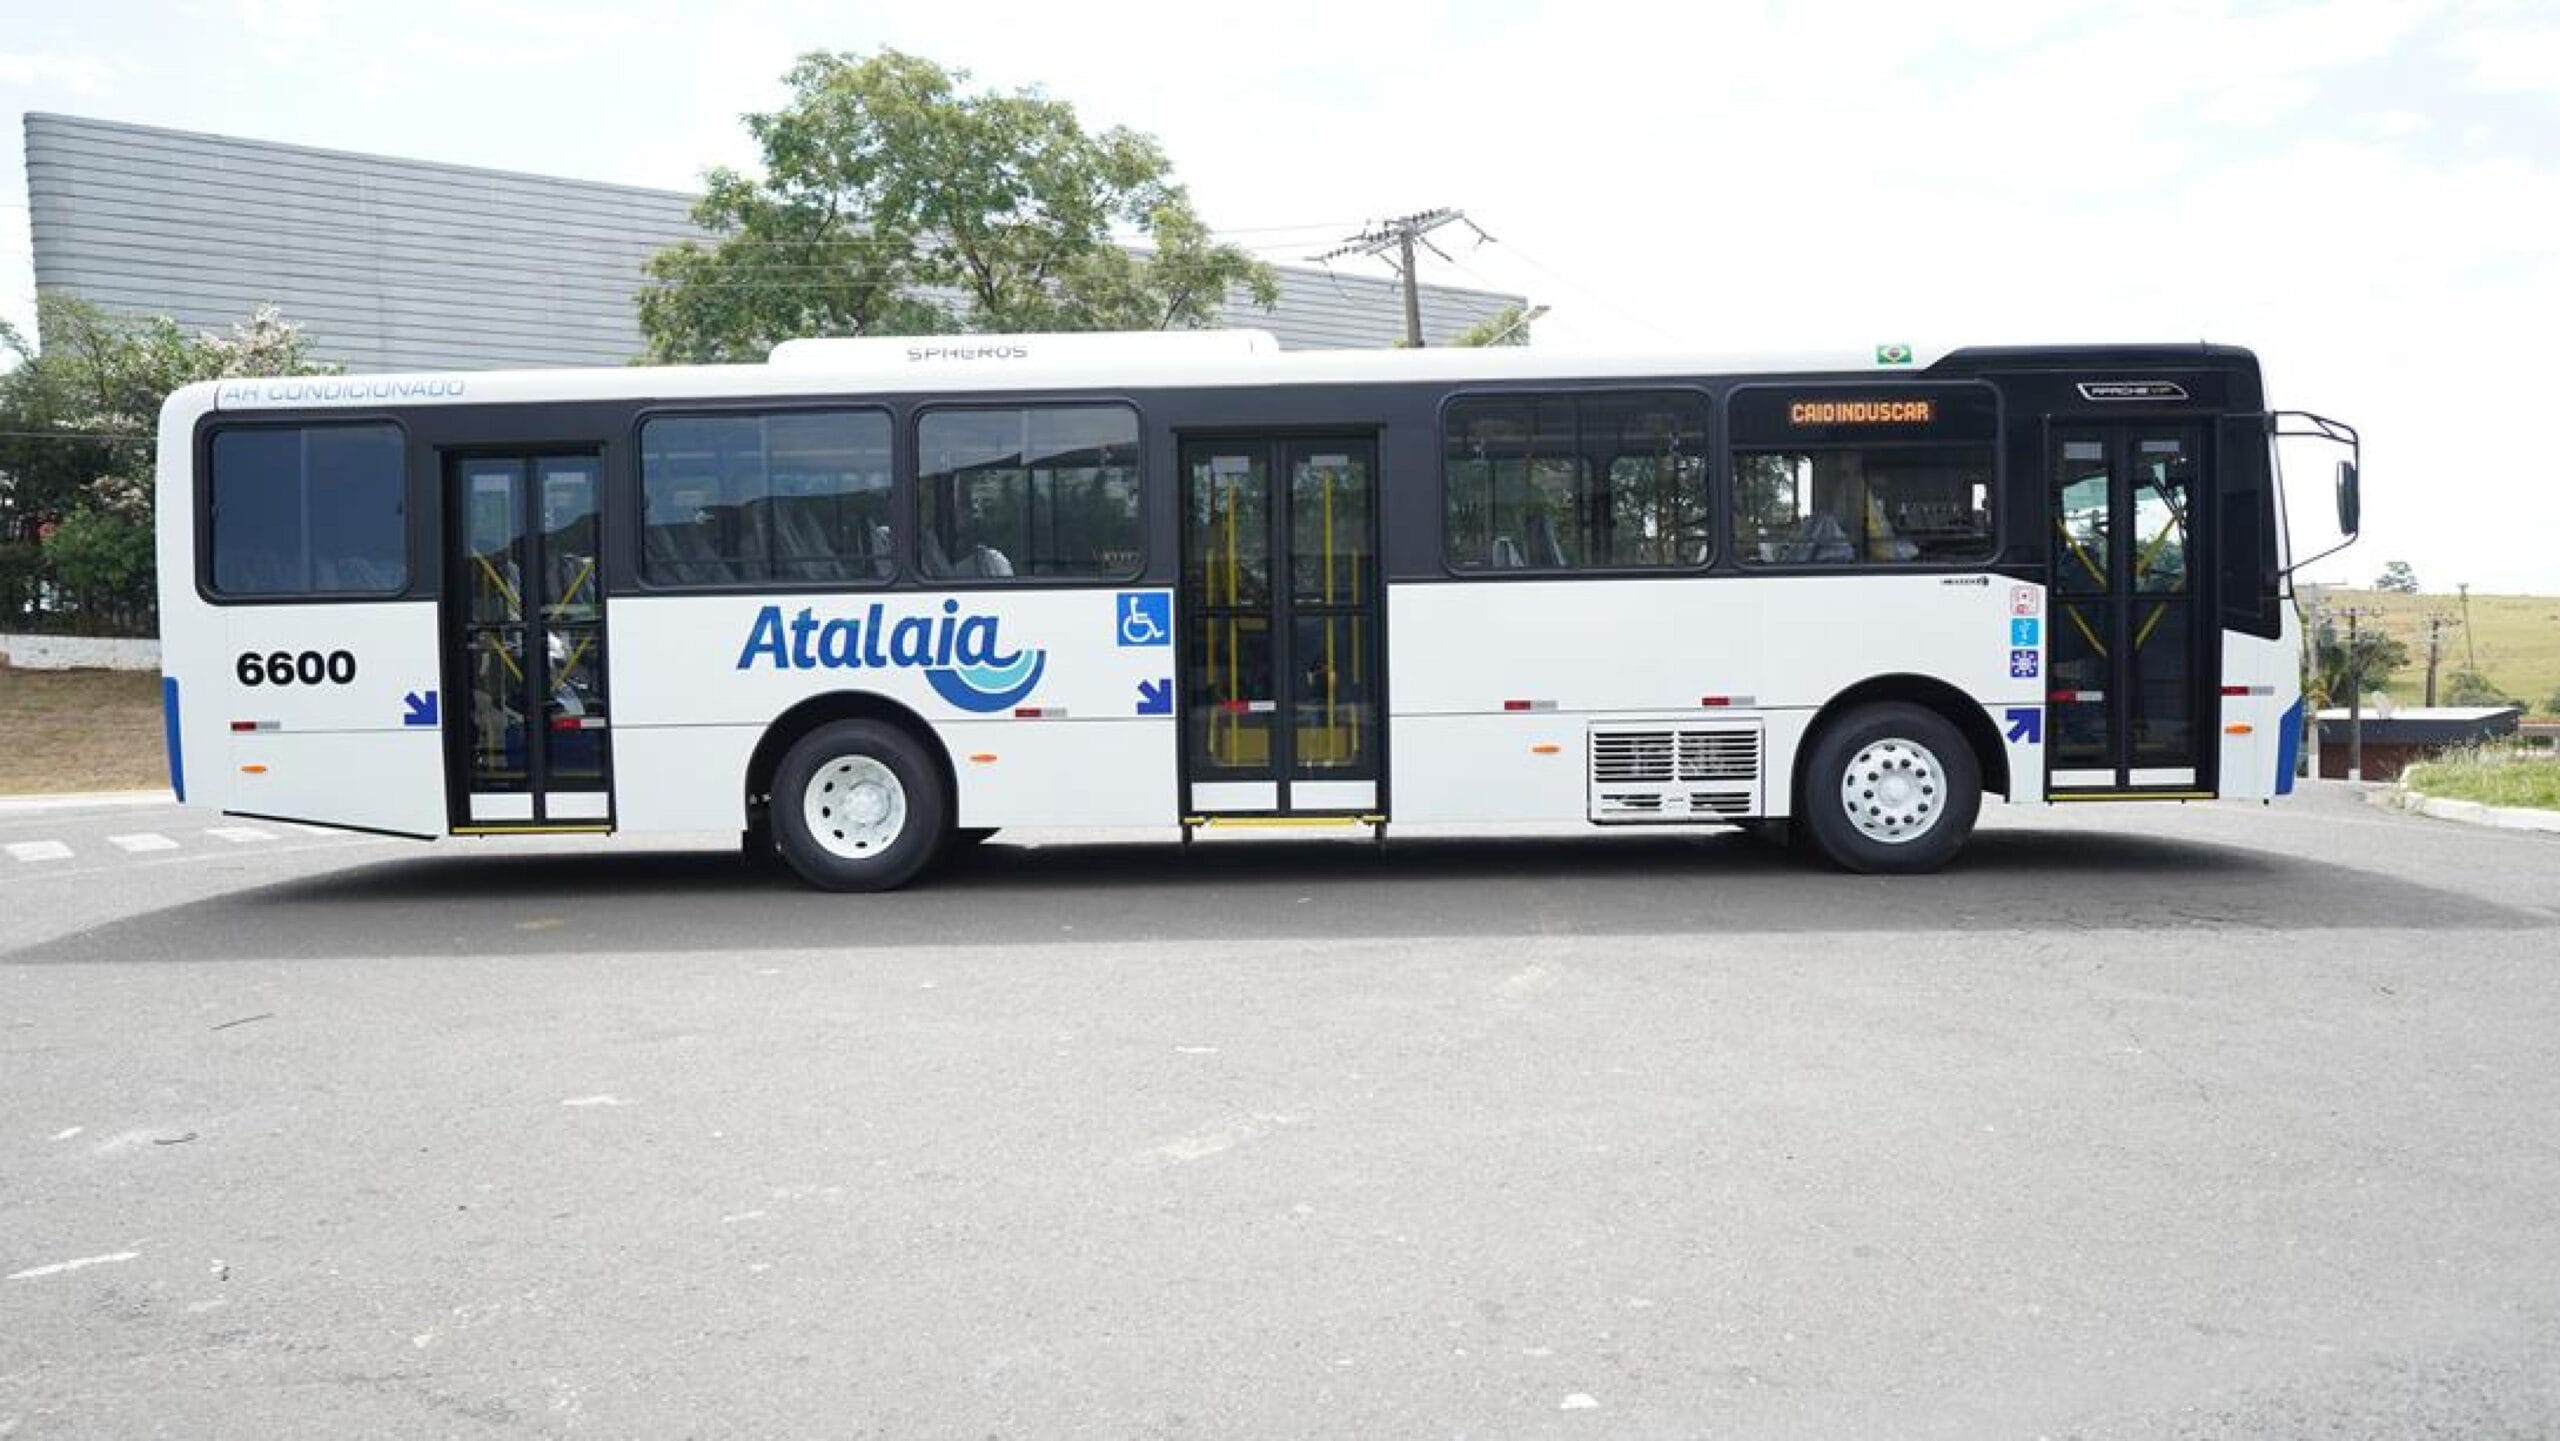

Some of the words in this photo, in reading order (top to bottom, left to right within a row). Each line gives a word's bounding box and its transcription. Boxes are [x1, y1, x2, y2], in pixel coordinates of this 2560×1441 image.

[906, 345, 1028, 361] SPHEROS
[268, 379, 464, 400] CONDICIONADO
[736, 598, 1023, 669] Atalaia
[237, 650, 356, 686] 6600
